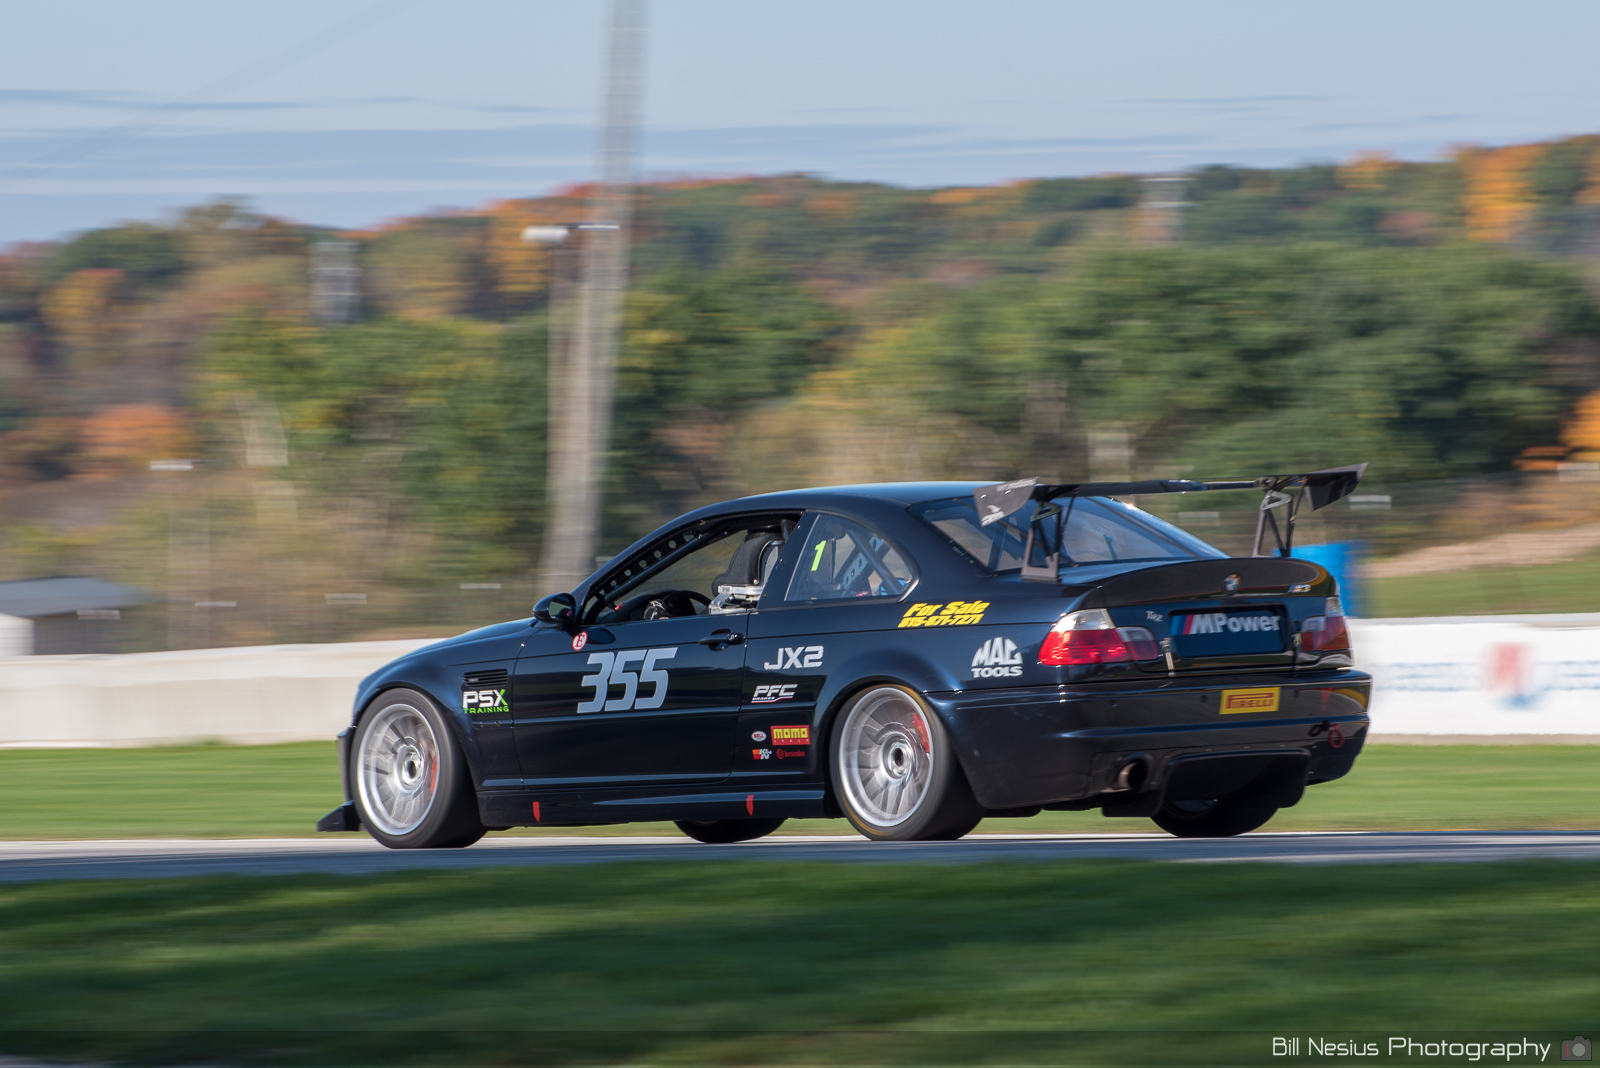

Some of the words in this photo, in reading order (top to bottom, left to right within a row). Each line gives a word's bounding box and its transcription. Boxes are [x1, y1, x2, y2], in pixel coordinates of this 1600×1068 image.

[810, 540, 827, 572] 1
[903, 602, 943, 618] For
[940, 600, 990, 616] Sale
[763, 645, 824, 670] JX2
[971, 636, 1023, 668] MAC
[576, 647, 679, 714] 355
[970, 666, 1023, 679] TOOLS
[462, 688, 509, 709] PSX
[752, 683, 799, 698] PFC
[462, 705, 510, 715] TRAINING
[1226, 692, 1275, 710] PIRELLI
